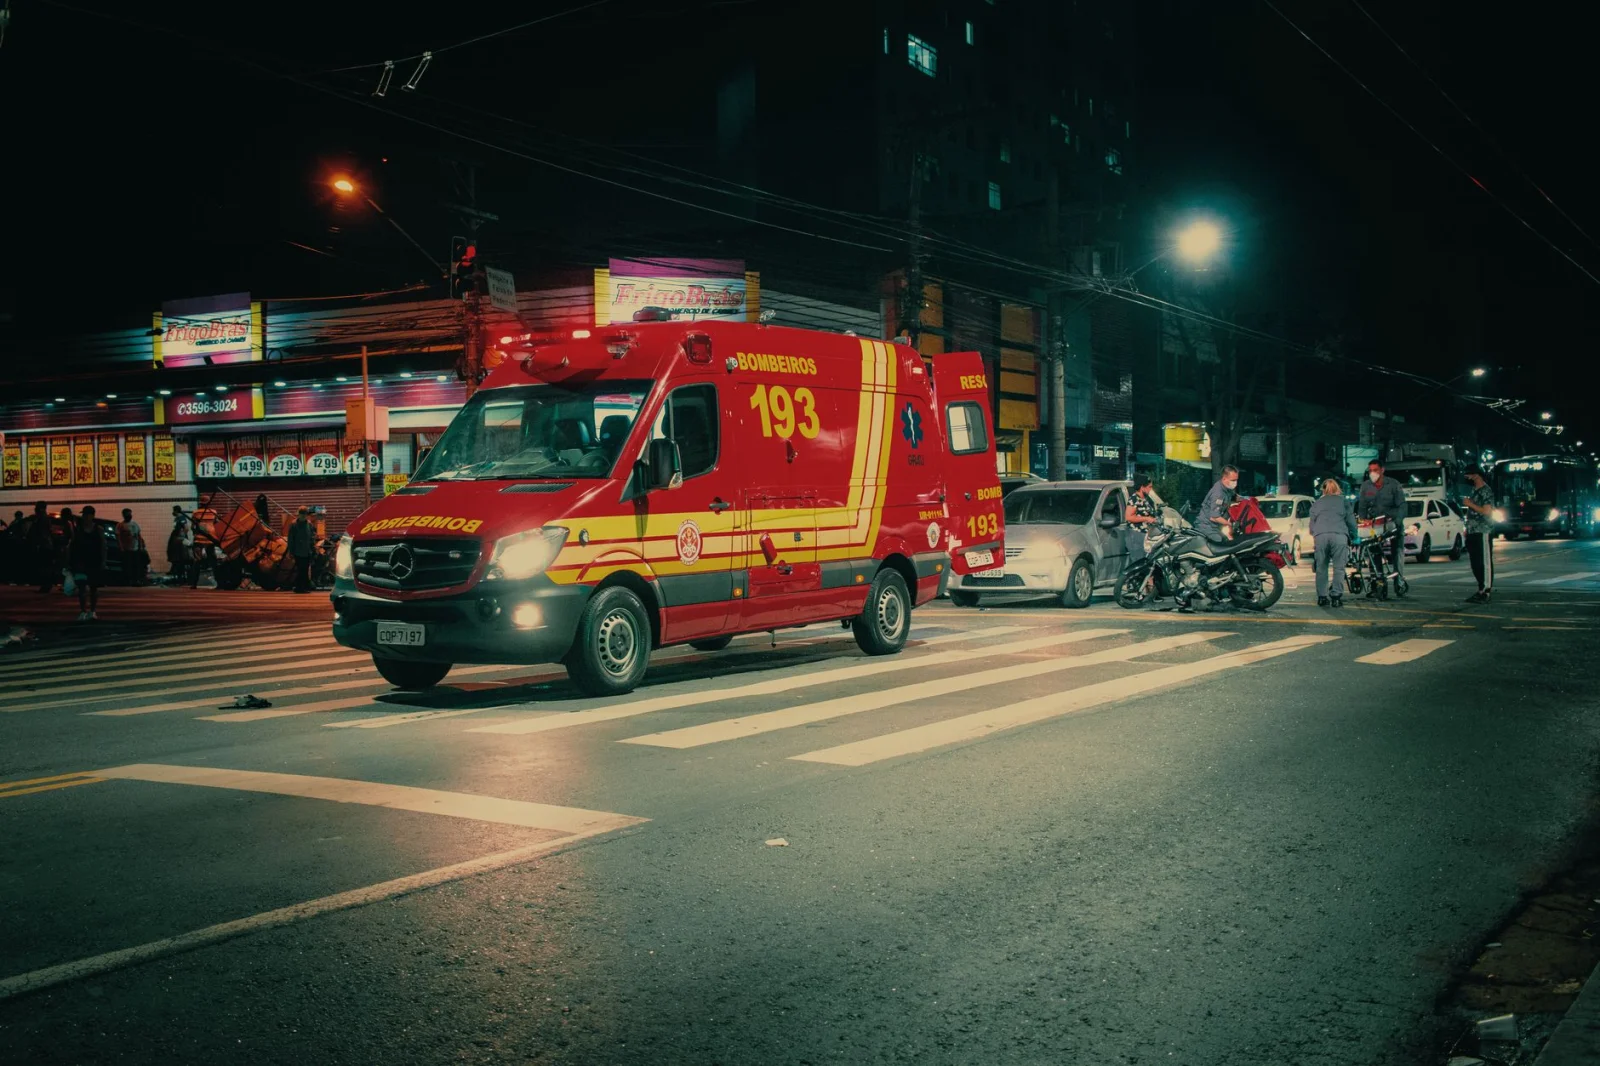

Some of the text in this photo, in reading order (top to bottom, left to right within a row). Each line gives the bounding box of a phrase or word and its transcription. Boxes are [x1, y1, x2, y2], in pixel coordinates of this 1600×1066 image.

[736, 351, 817, 375] BOMBEIROS
[185, 399, 238, 415] 3596-3024
[750, 384, 820, 439] 193
[977, 486, 1003, 501] BOMB
[967, 513, 999, 538] 193
